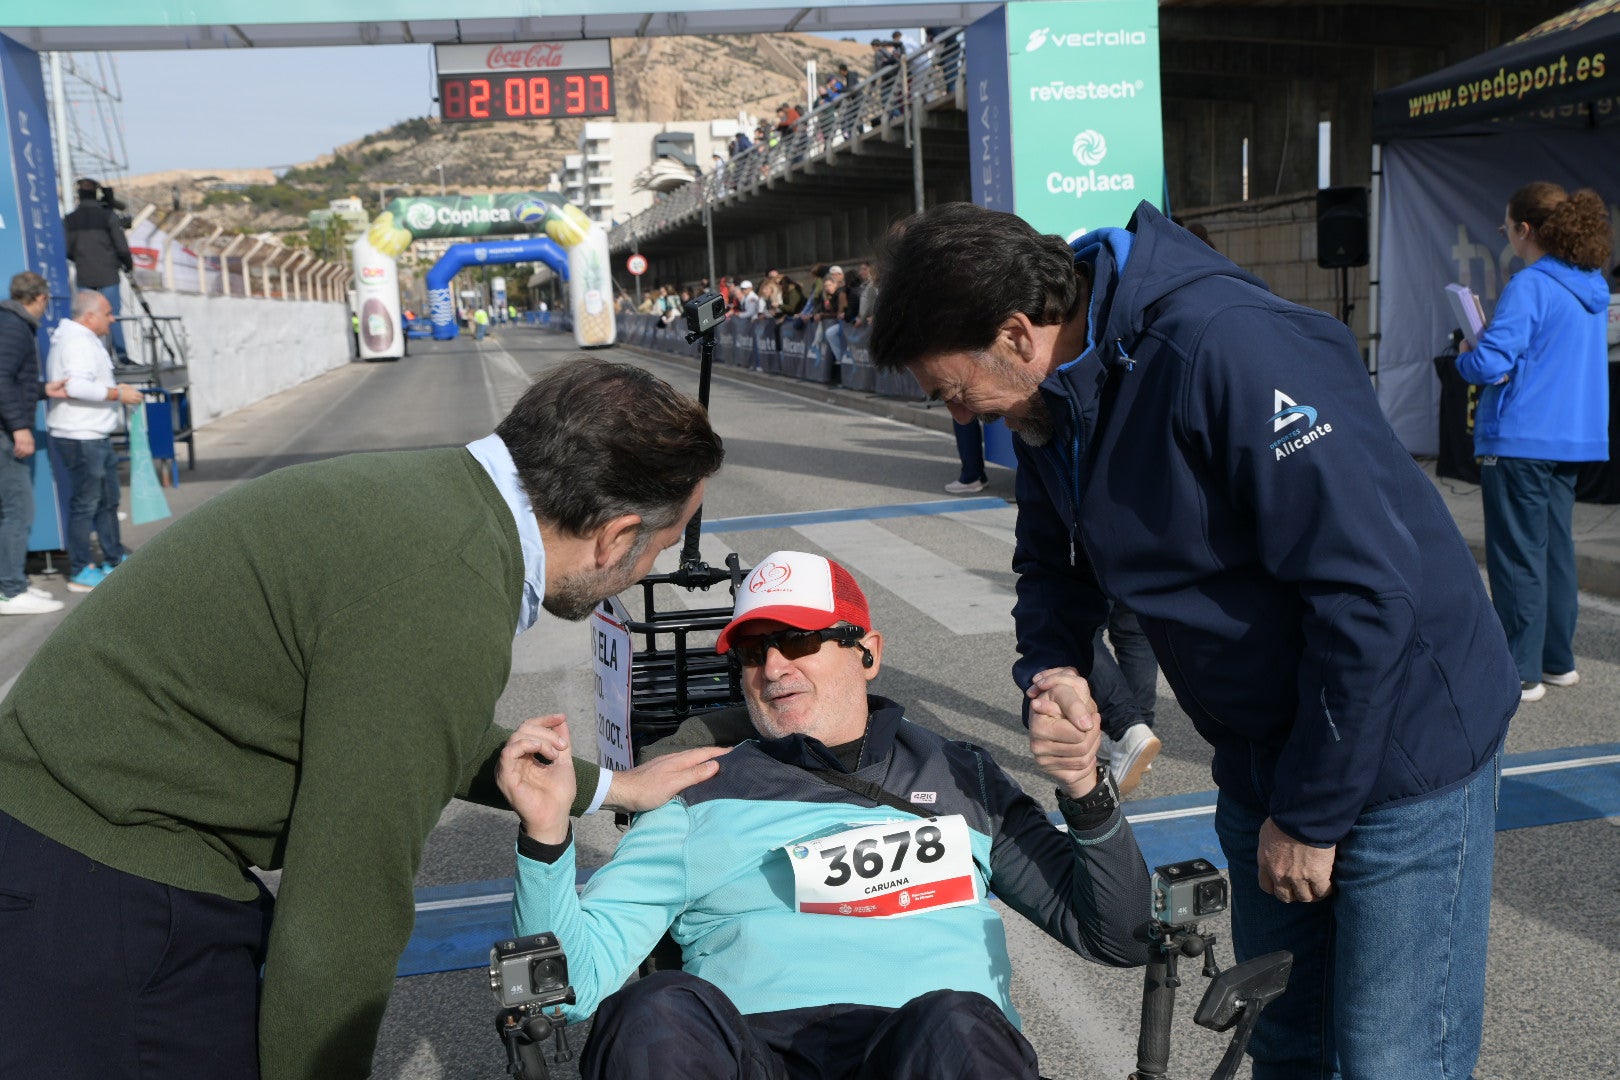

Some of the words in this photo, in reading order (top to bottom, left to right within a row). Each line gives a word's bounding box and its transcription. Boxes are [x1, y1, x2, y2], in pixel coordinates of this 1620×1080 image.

[1051, 29, 1146, 48] vectalia
[1408, 51, 1606, 118] www.evedeport.es
[1046, 169, 1135, 198] Coplaca
[437, 205, 511, 228] Coplaca
[1275, 423, 1333, 461] Alicante
[598, 630, 618, 672] ELA
[605, 718, 623, 750] OCT.
[820, 825, 946, 887] 3678
[864, 877, 910, 895] CARUANA
[510, 984, 523, 992] 4K
